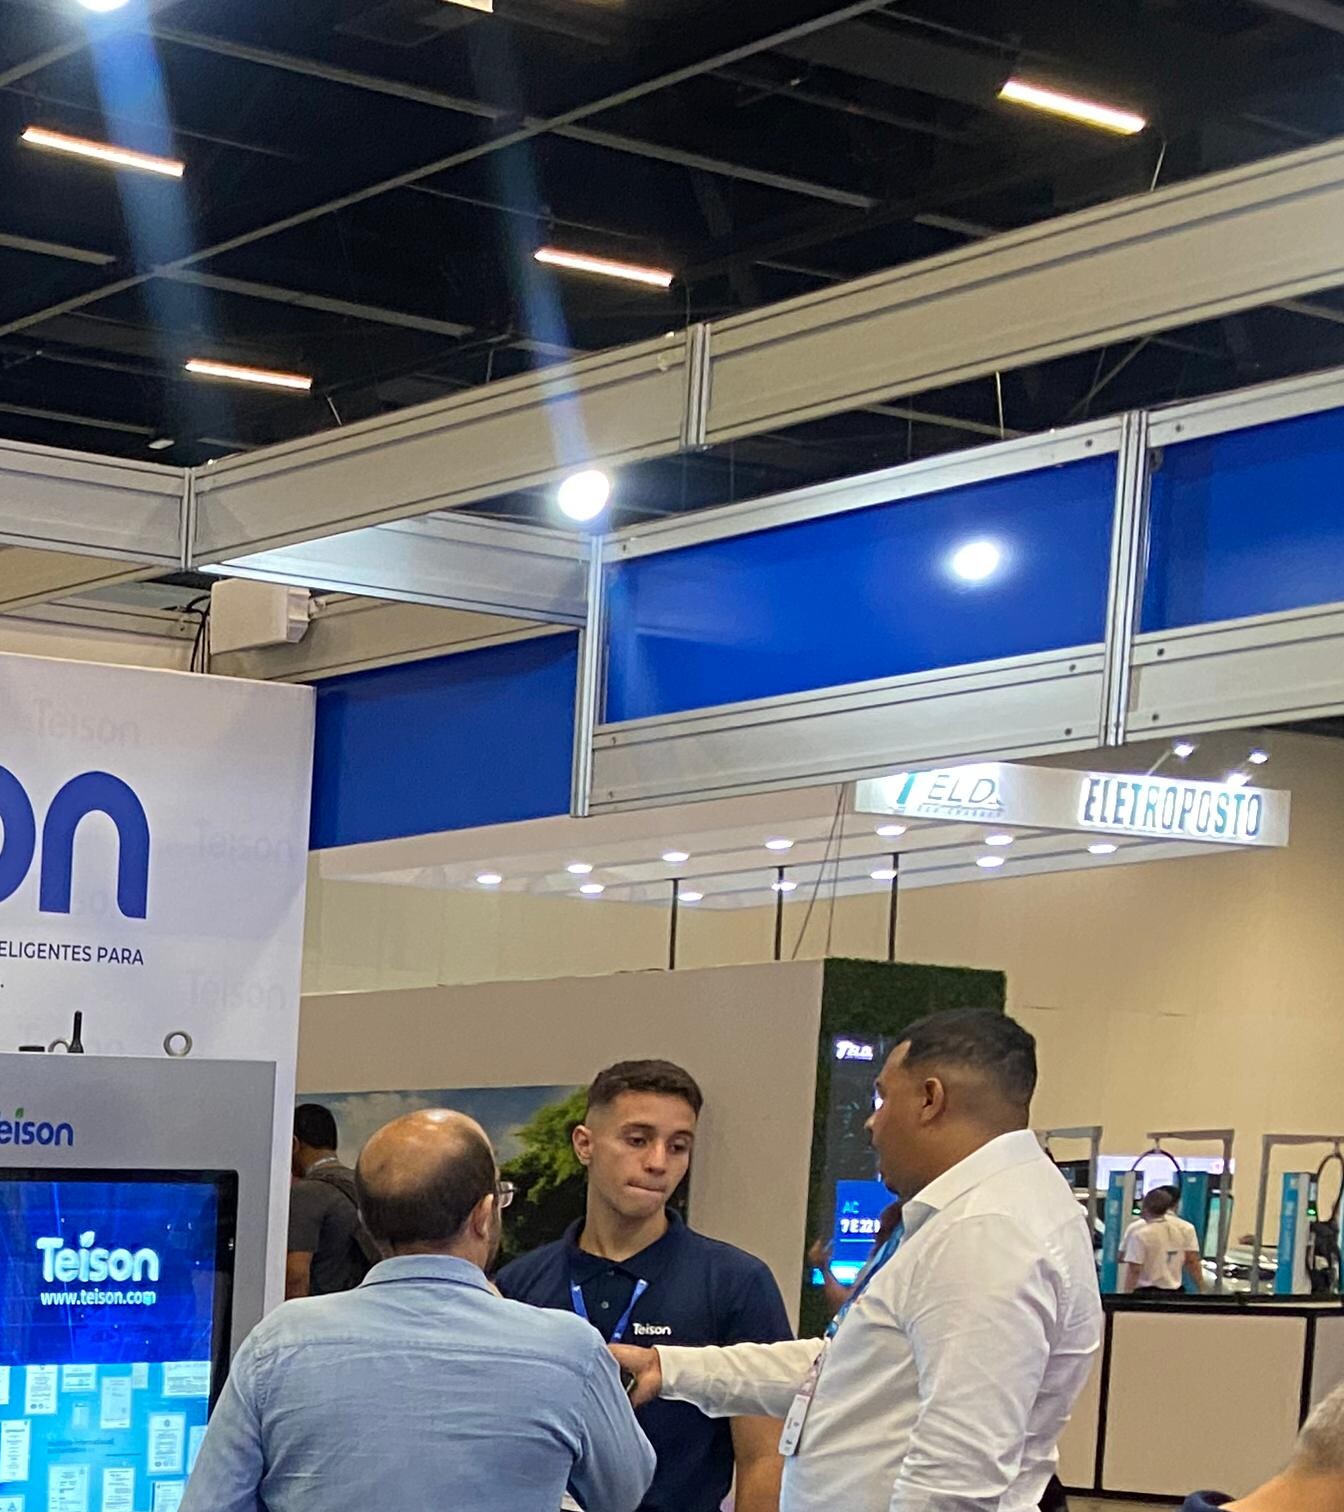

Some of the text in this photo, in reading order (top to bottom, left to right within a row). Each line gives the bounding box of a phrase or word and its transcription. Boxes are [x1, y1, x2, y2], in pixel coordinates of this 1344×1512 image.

[1084, 778, 1263, 836] ELETROPOSTO
[96, 946, 144, 966] PARA
[842, 1200, 860, 1214] AC
[35, 1231, 160, 1283] Teison
[40, 1288, 156, 1306] www.teison.com
[632, 1322, 672, 1336] Teison
